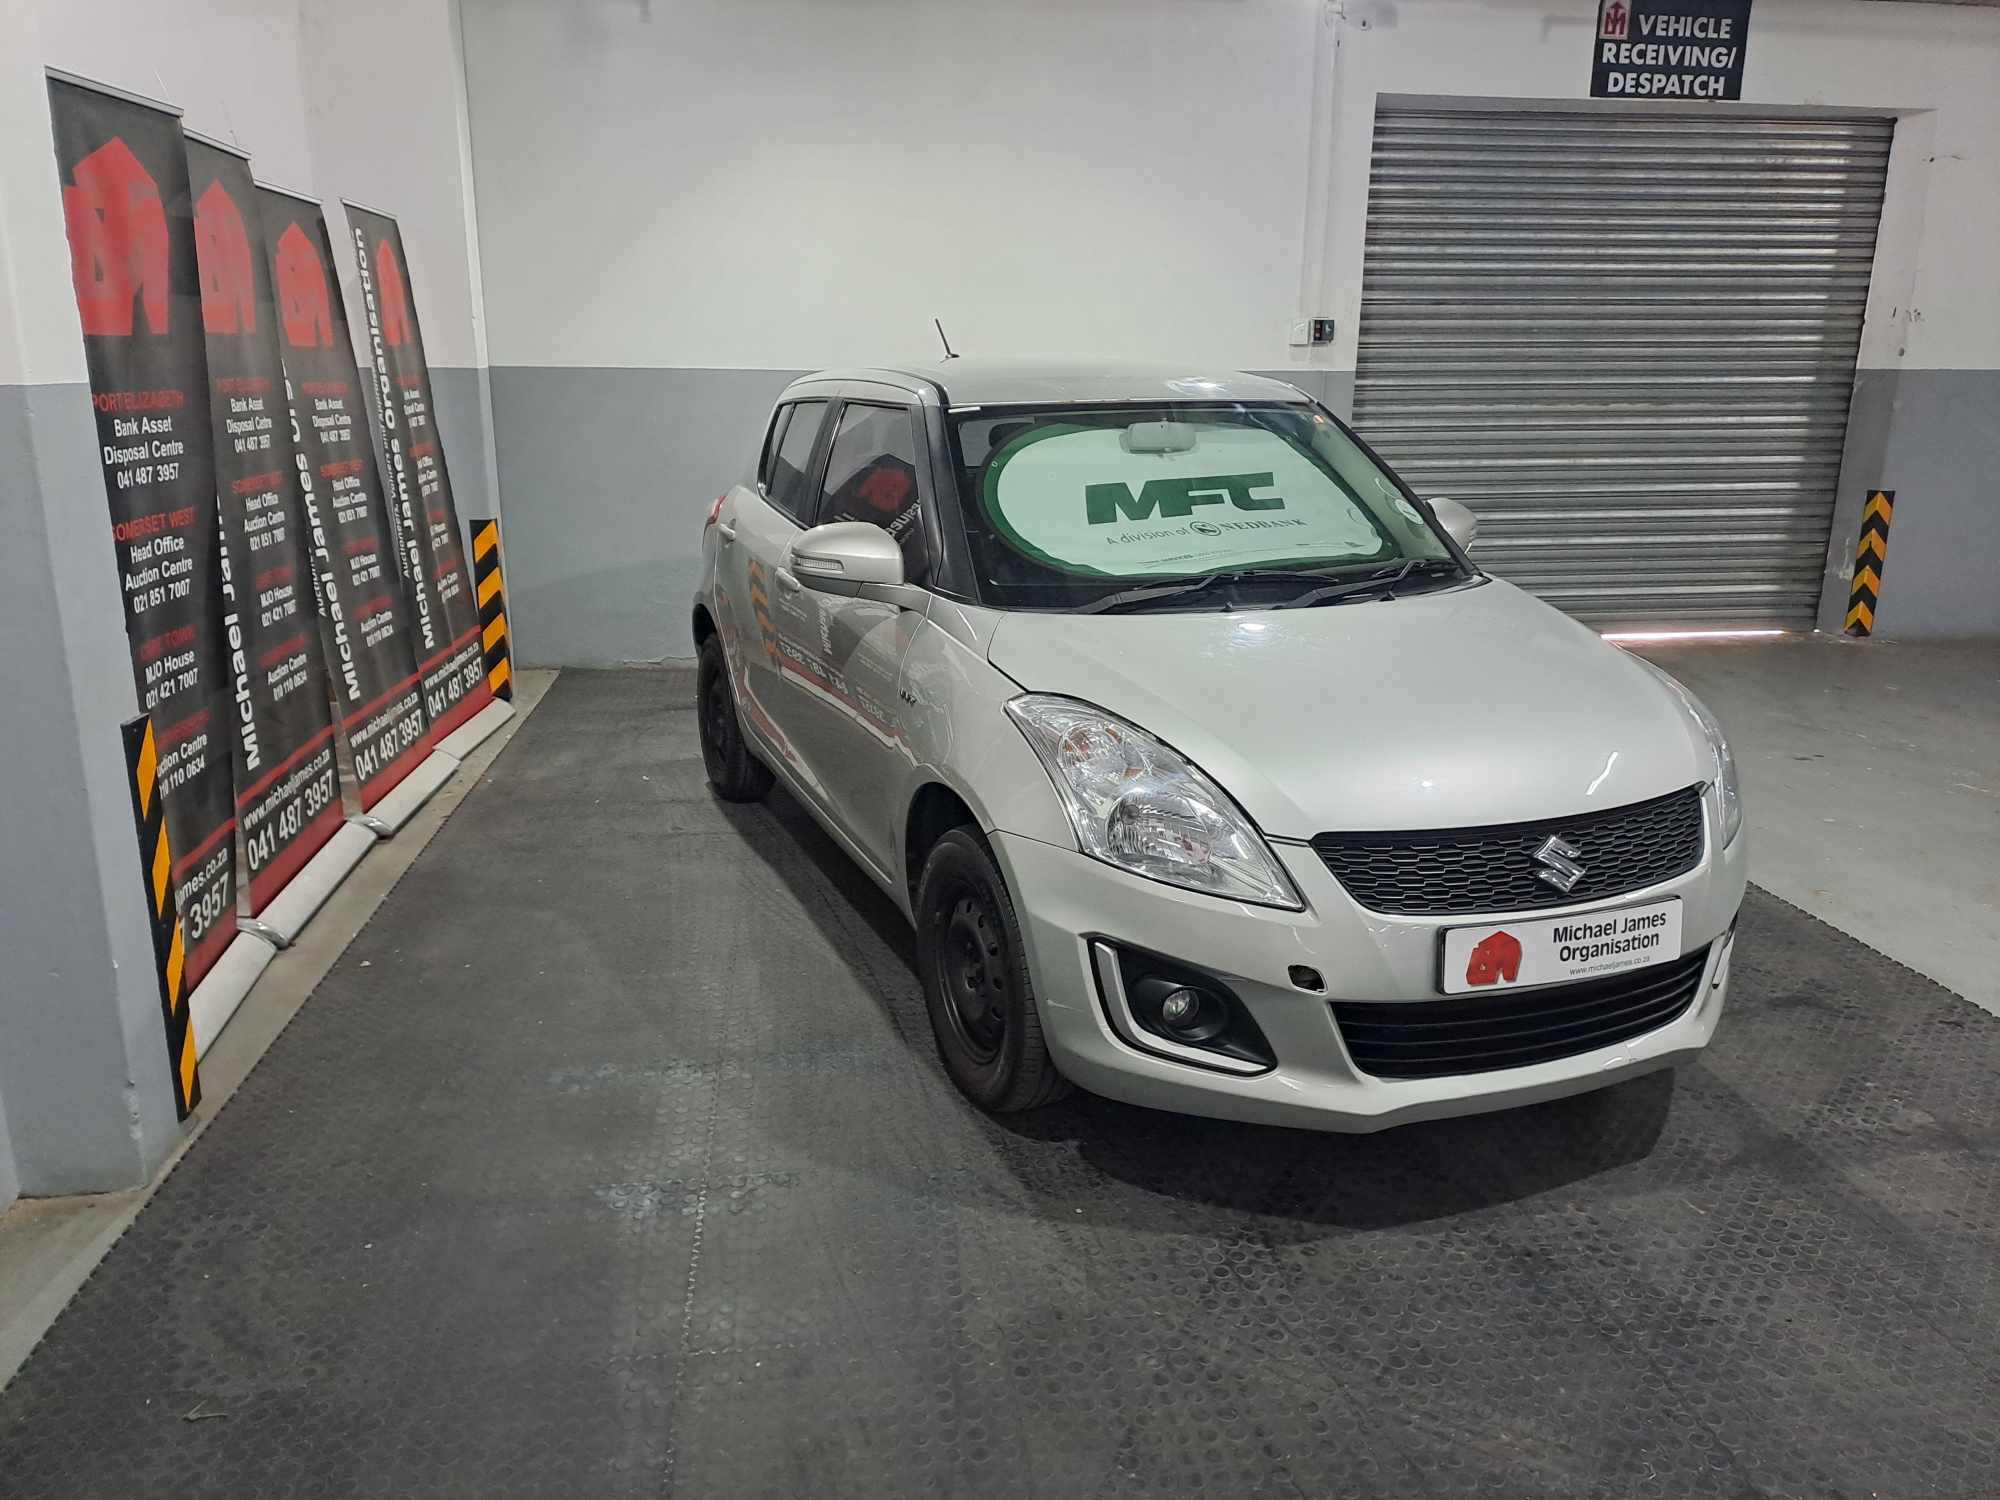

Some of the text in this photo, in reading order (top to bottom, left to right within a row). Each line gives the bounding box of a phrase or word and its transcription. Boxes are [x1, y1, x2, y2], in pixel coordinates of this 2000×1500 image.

[1639, 14, 1732, 39] VEHICLE
[1602, 42, 1737, 69] RECEIVING/
[1607, 71, 1725, 97] DESPATCH
[114, 415, 173, 437] Bank Asset
[103, 440, 184, 466] Disposal Centre
[117, 462, 180, 489] 041 487 3957
[391, 438, 414, 531] James
[1085, 472, 1286, 525] MFC
[1105, 518, 1308, 545] A division of NEDBANK
[130, 536, 185, 564] Head Office
[125, 556, 193, 592] Auction Centre
[133, 578, 191, 614] 021 851 7007
[405, 539, 435, 650] Michael
[320, 572, 360, 701] Michael
[145, 651, 195, 685] MJO House
[145, 667, 199, 710] 021 421 7007
[223, 613, 261, 771] Michael
[427, 687, 448, 718] 041
[463, 656, 484, 688] 3957
[180, 734, 208, 759] Centre
[355, 708, 423, 781] 041 487 3957
[170, 768, 185, 790] 110
[186, 754, 205, 779] 0634
[243, 748, 330, 831] www.michaeljames.co.za
[248, 768, 334, 870] 041 487 3957
[190, 872, 229, 938] 3957
[1552, 912, 1667, 944] Michael James
[1559, 933, 1660, 962] Organisation
